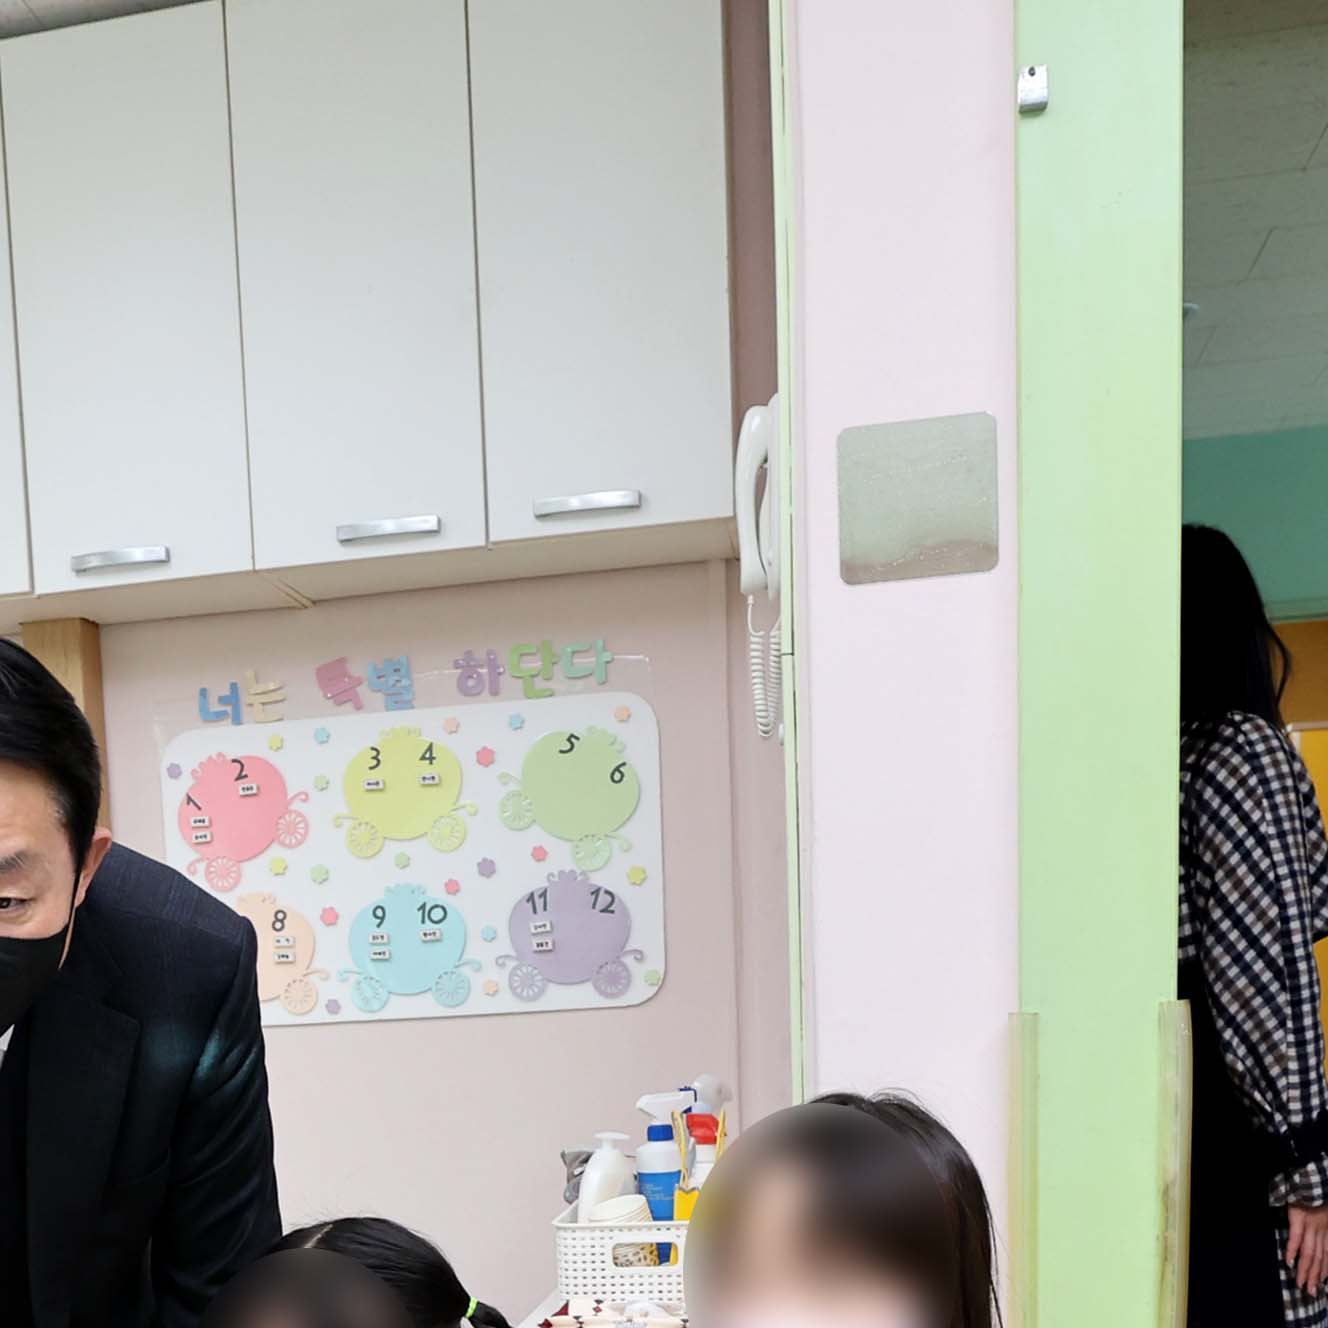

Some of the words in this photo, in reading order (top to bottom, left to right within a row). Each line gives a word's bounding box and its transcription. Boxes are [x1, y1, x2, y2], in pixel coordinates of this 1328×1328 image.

[199, 670, 288, 725] 너는
[419, 741, 436, 765] 4
[558, 733, 580, 754] 5
[231, 758, 249, 782] 2
[368, 746, 381, 771] 3
[610, 761, 627, 784] 6
[186, 792, 202, 811] 1
[526, 887, 548, 915] 11
[590, 887, 616, 914] 12
[272, 909, 287, 932] 8
[372, 905, 386, 929] 9
[417, 901, 448, 925] 10
